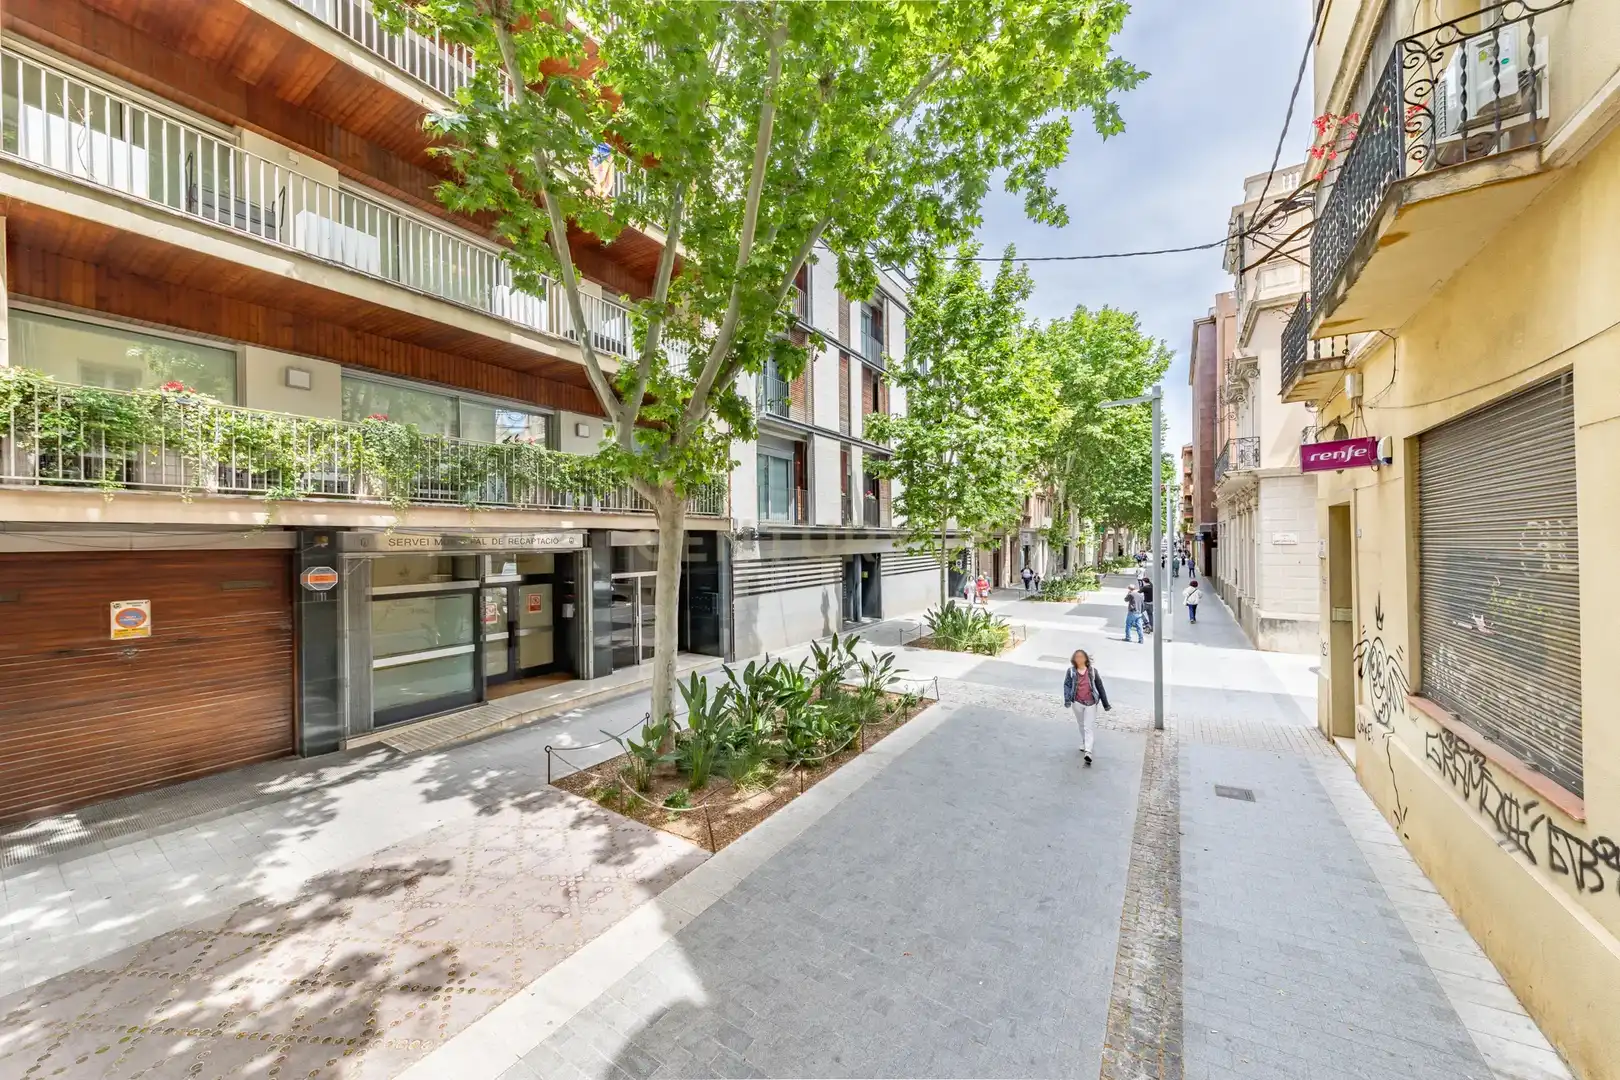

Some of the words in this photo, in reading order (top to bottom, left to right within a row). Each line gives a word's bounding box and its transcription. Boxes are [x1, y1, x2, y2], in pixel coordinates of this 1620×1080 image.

[1310, 444, 1367, 462] renfe
[388, 537, 430, 547] SERVEI
[434, 537, 486, 546] MUPAL
[491, 537, 504, 546] DE
